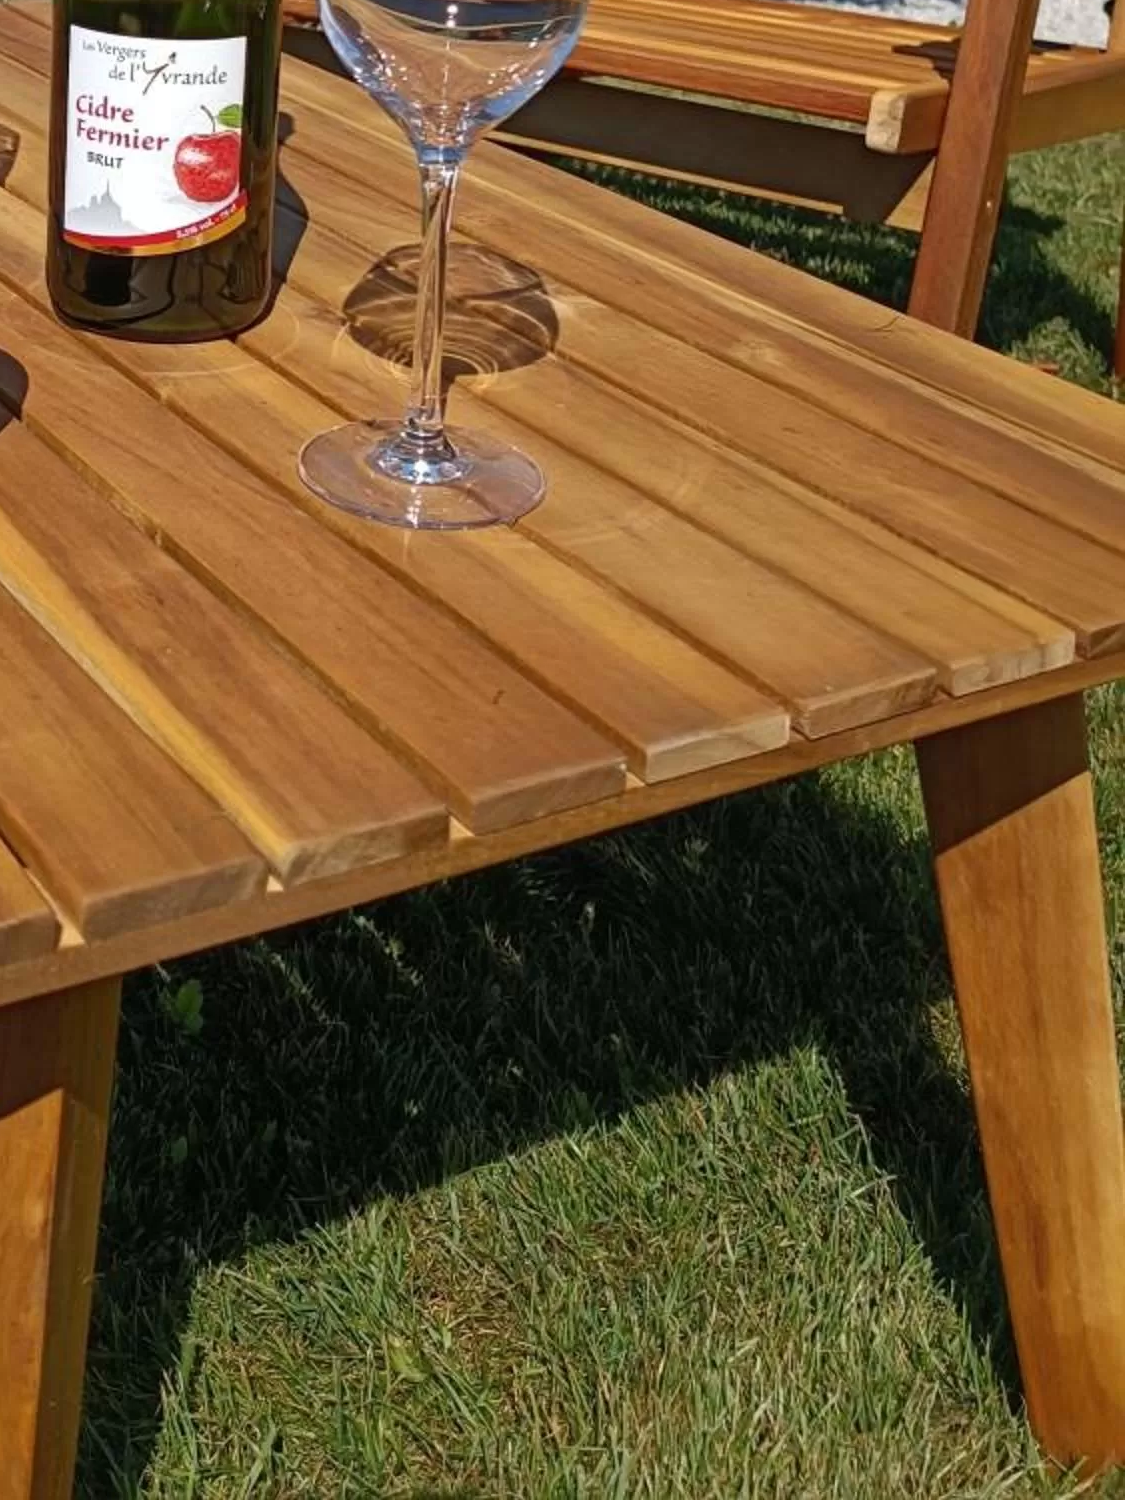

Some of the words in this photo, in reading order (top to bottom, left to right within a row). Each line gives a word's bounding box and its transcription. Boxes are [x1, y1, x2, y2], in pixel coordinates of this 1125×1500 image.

[97, 40, 146, 62] Vergers
[108, 64, 126, 81] de
[76, 94, 135, 123] Cidre
[76, 118, 170, 151] Fermier
[86, 151, 124, 169] BRUT
